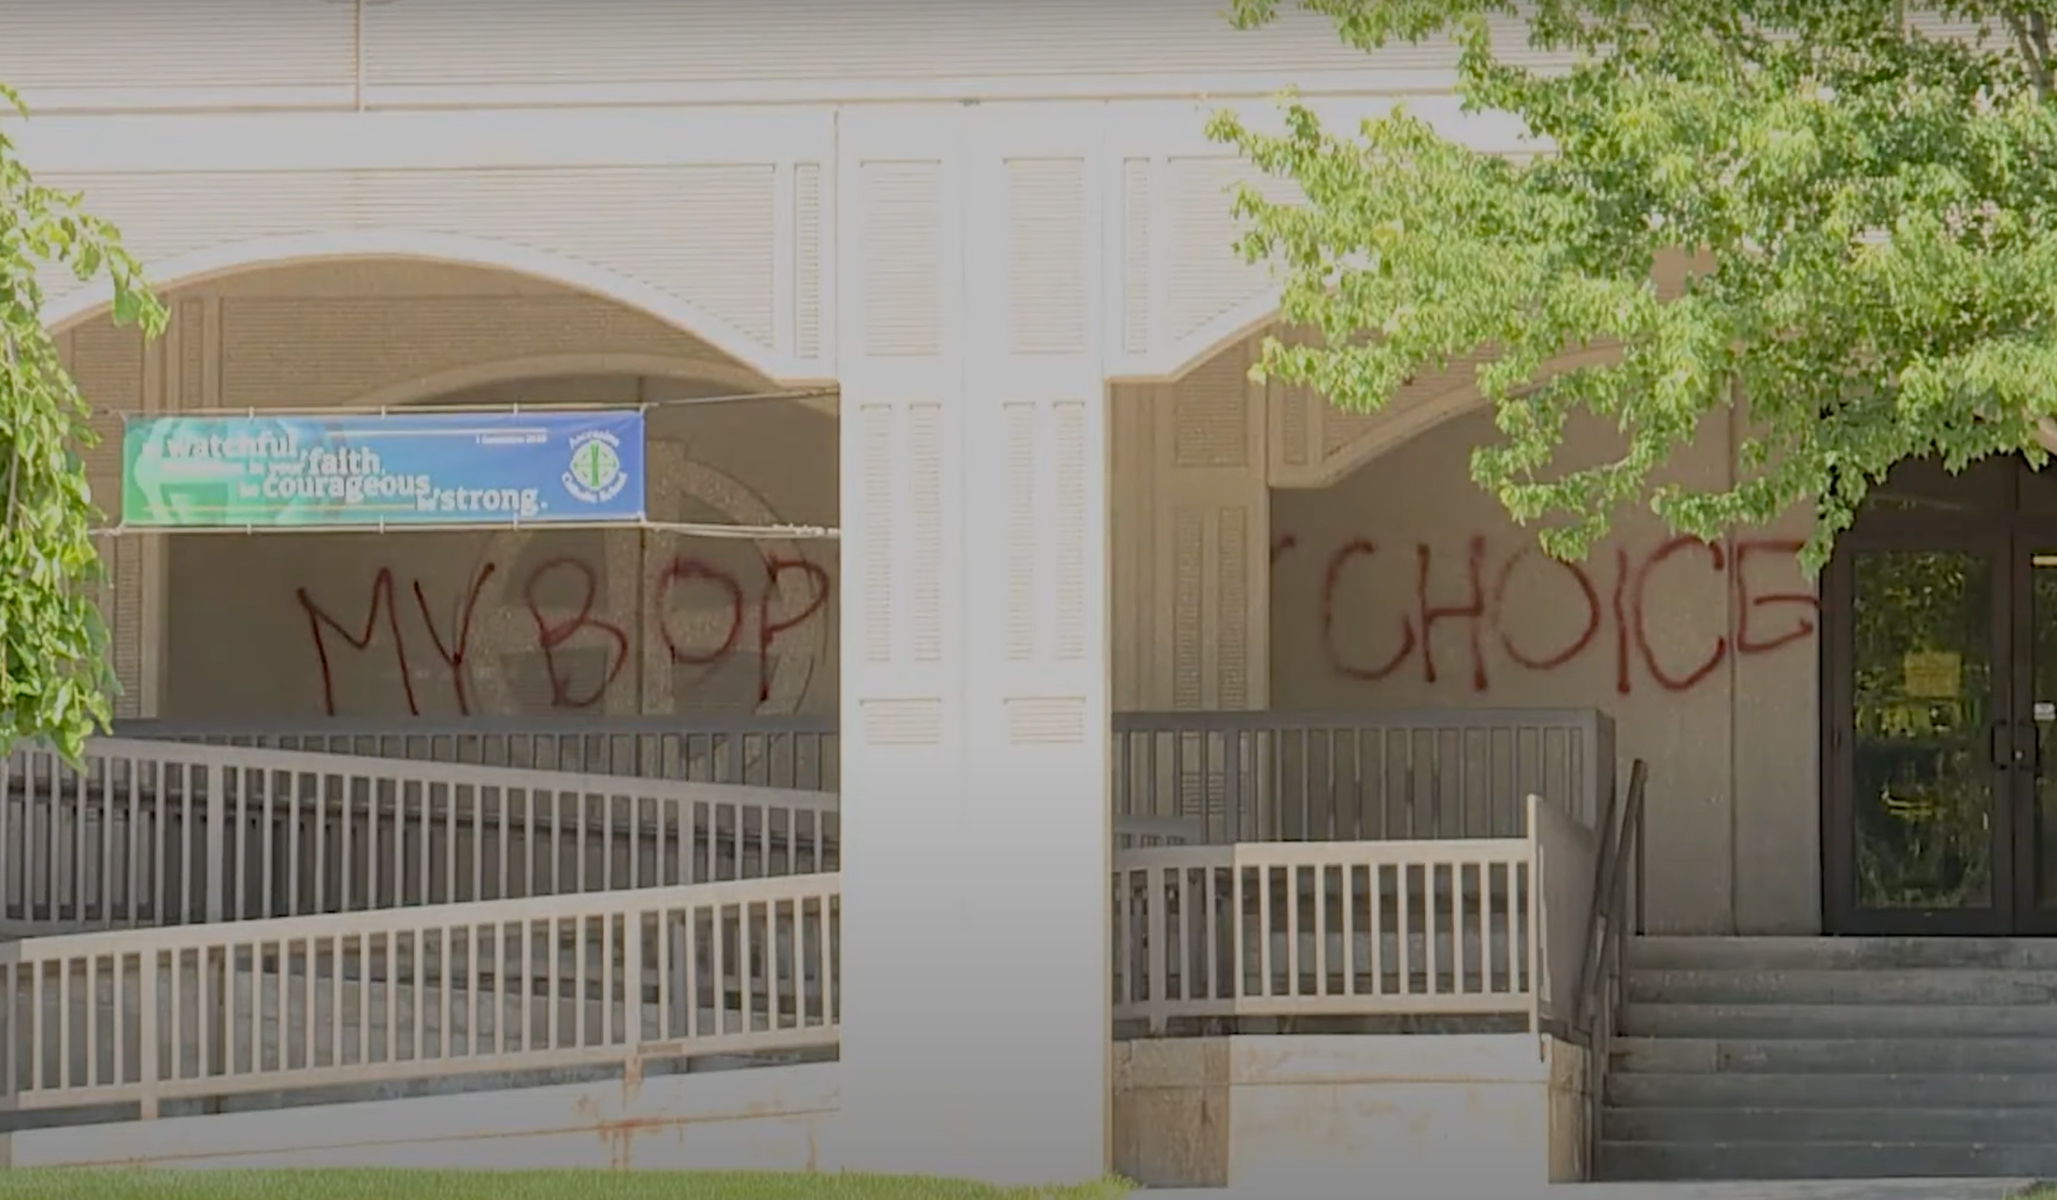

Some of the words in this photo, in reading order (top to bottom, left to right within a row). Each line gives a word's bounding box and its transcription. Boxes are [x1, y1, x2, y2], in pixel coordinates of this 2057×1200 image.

[440, 485, 549, 517] strong.
[295, 561, 495, 717] MY
[1322, 534, 1820, 695] CHOICE
